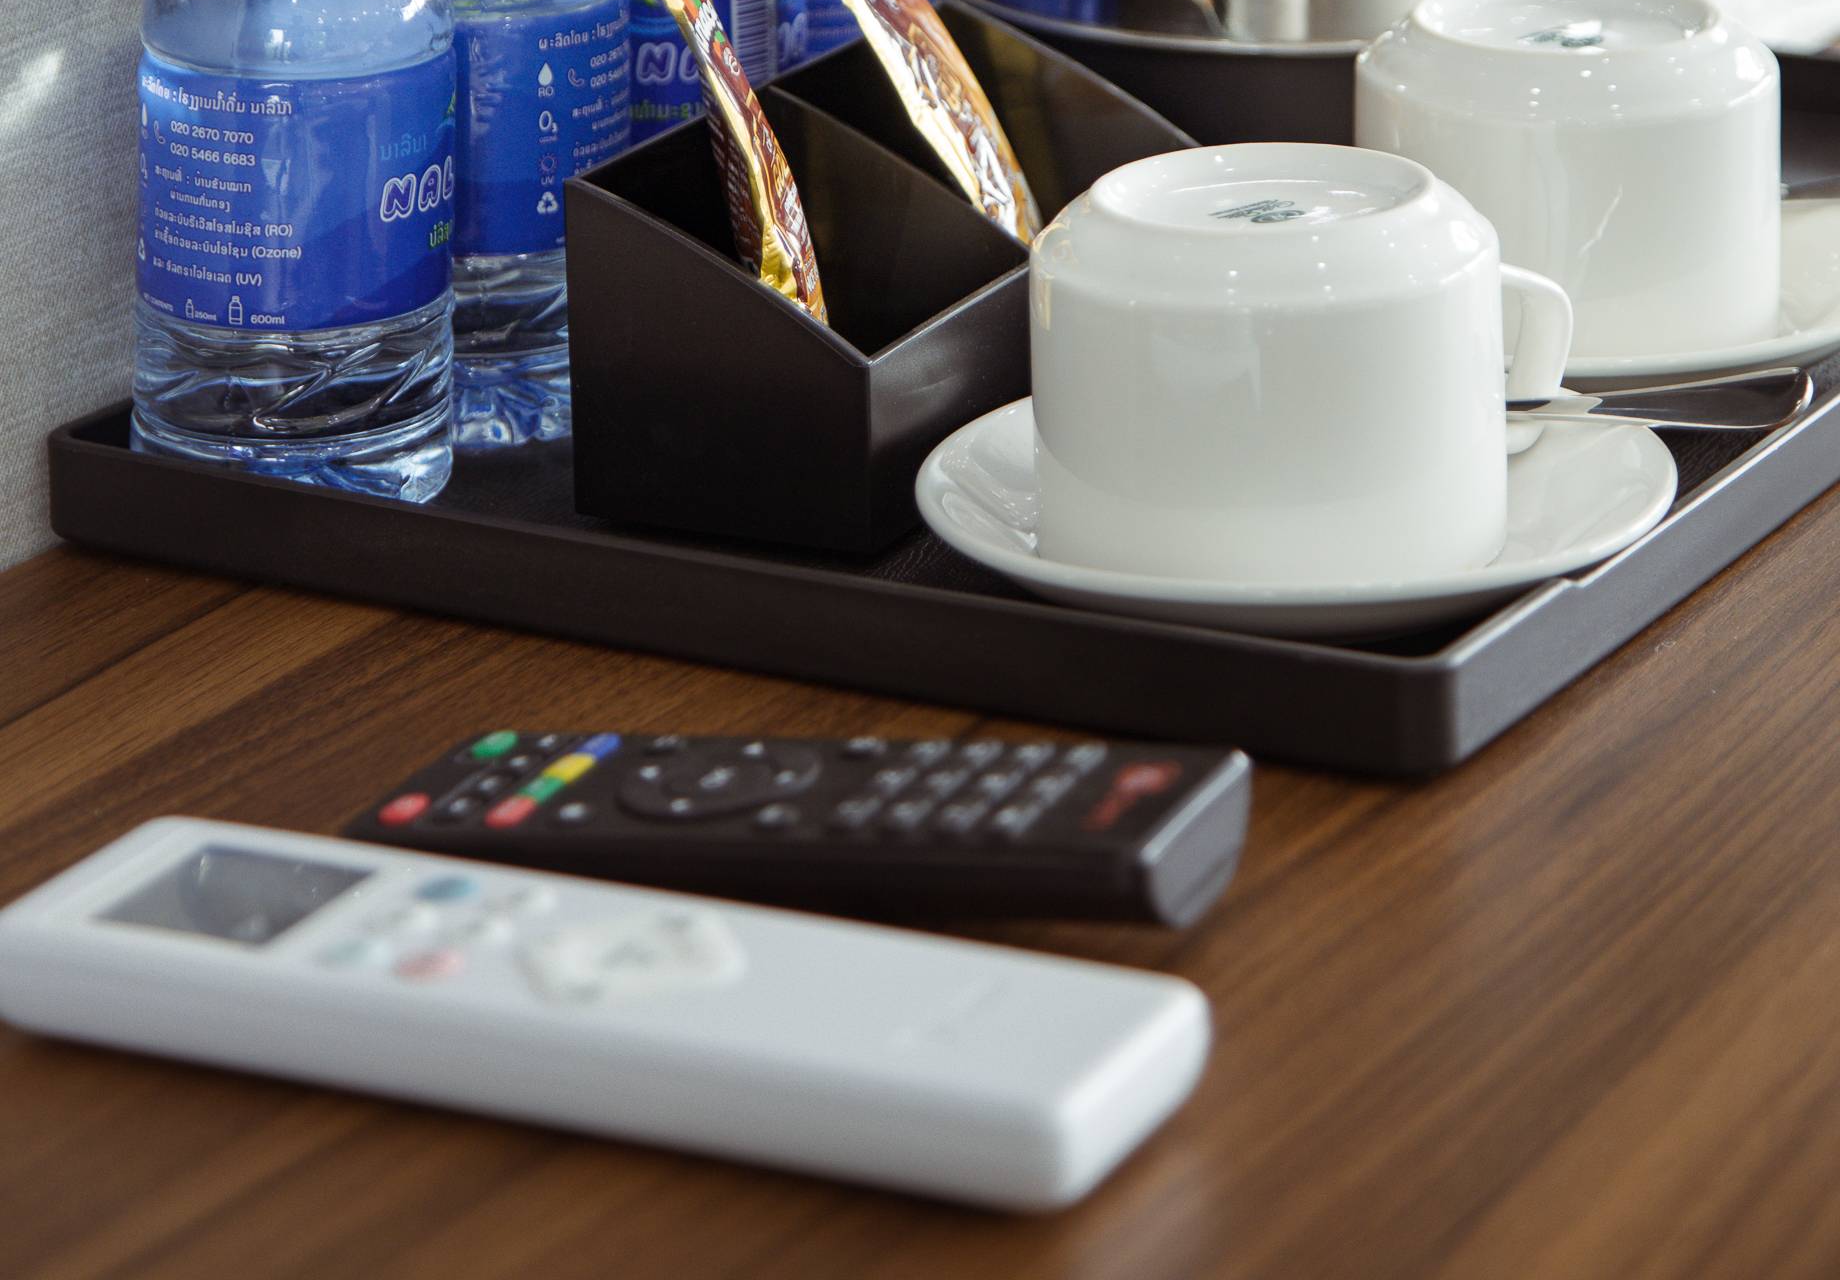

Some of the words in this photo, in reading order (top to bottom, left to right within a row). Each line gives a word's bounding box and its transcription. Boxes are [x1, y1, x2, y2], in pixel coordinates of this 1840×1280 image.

[538, 86, 554, 97] RO
[170, 120, 189, 136] 020
[191, 126, 220, 141] 2670
[223, 130, 254, 145] 7070
[170, 142, 189, 157] 020
[191, 147, 220, 163] 5466
[223, 153, 256, 167] 6683
[541, 176, 554, 186] UV
[264, 224, 293, 239] (RO)
[251, 246, 302, 259] (Ozone)
[235, 273, 262, 287] (UV)
[250, 314, 285, 325] 600ml
